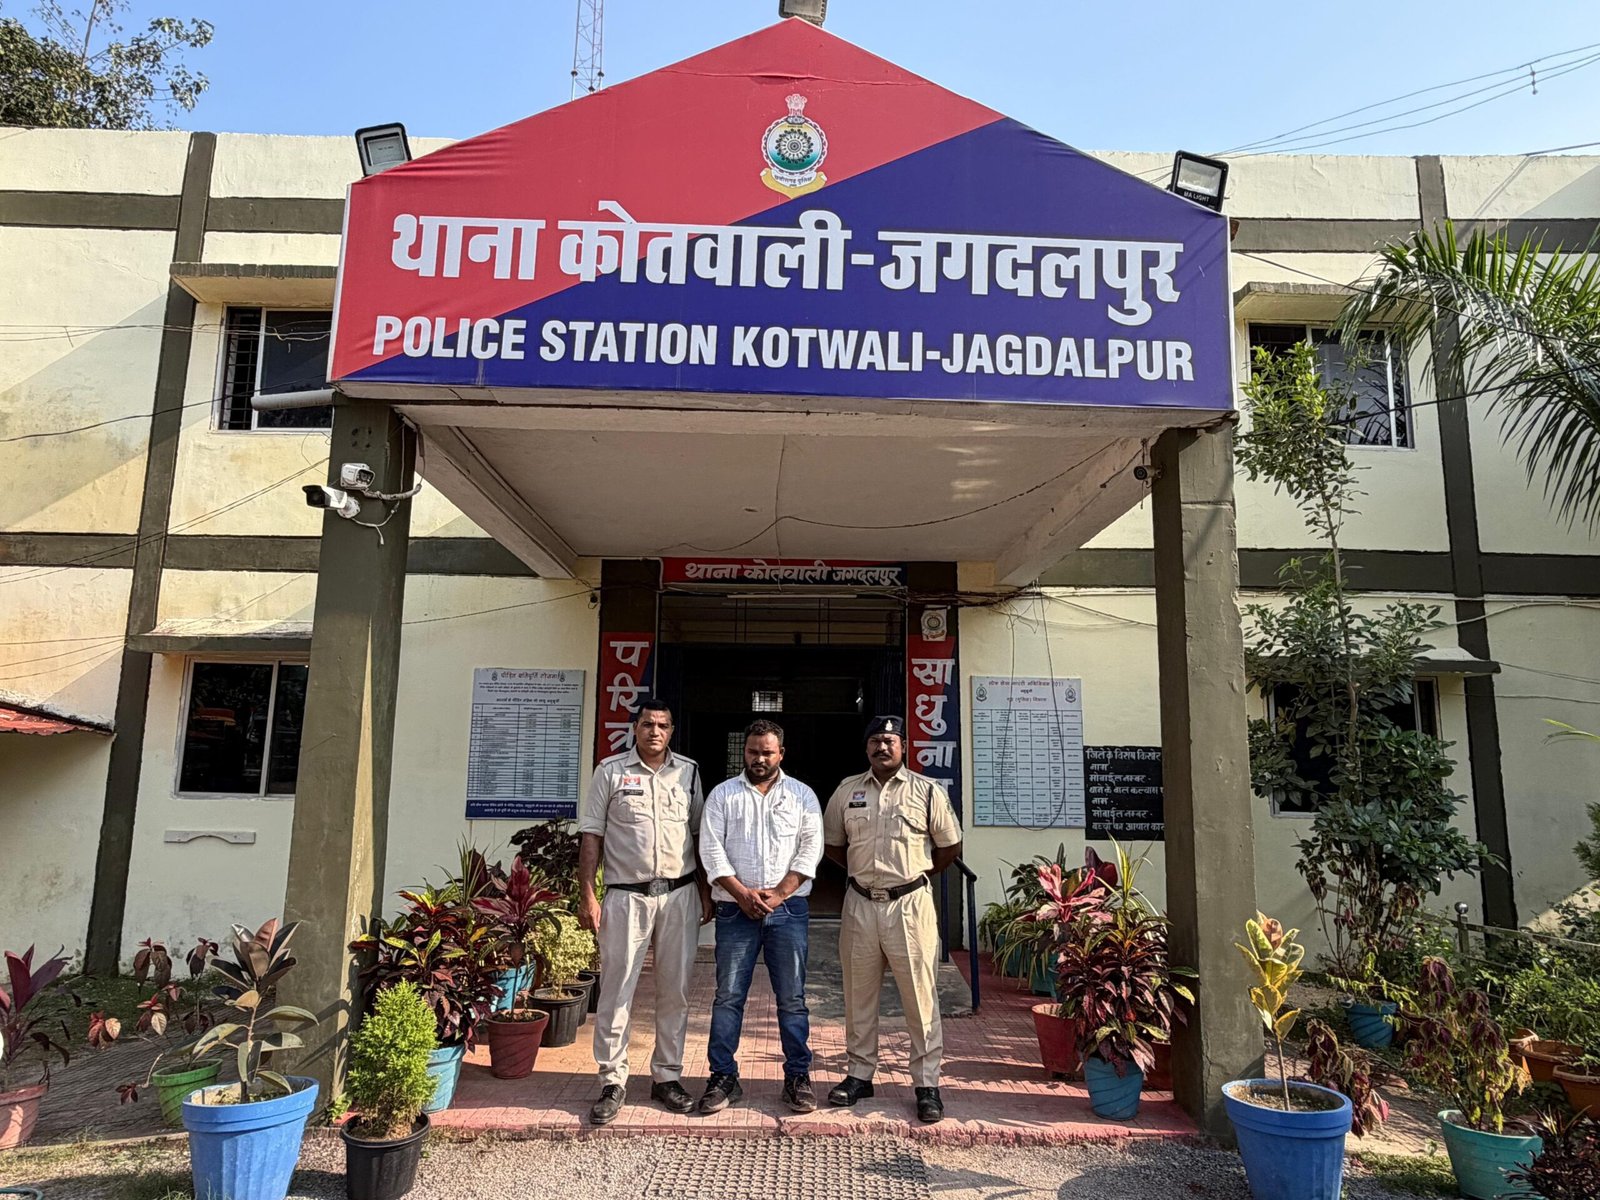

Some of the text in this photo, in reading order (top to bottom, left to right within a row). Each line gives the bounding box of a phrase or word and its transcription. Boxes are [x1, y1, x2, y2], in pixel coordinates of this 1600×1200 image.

[391, 214, 546, 280] थाना
[373, 315, 1195, 382] POLICE STATION KOTWALI-JAGDALPUR
[685, 559, 902, 586] थाना कोतवाली जगदलपुर
